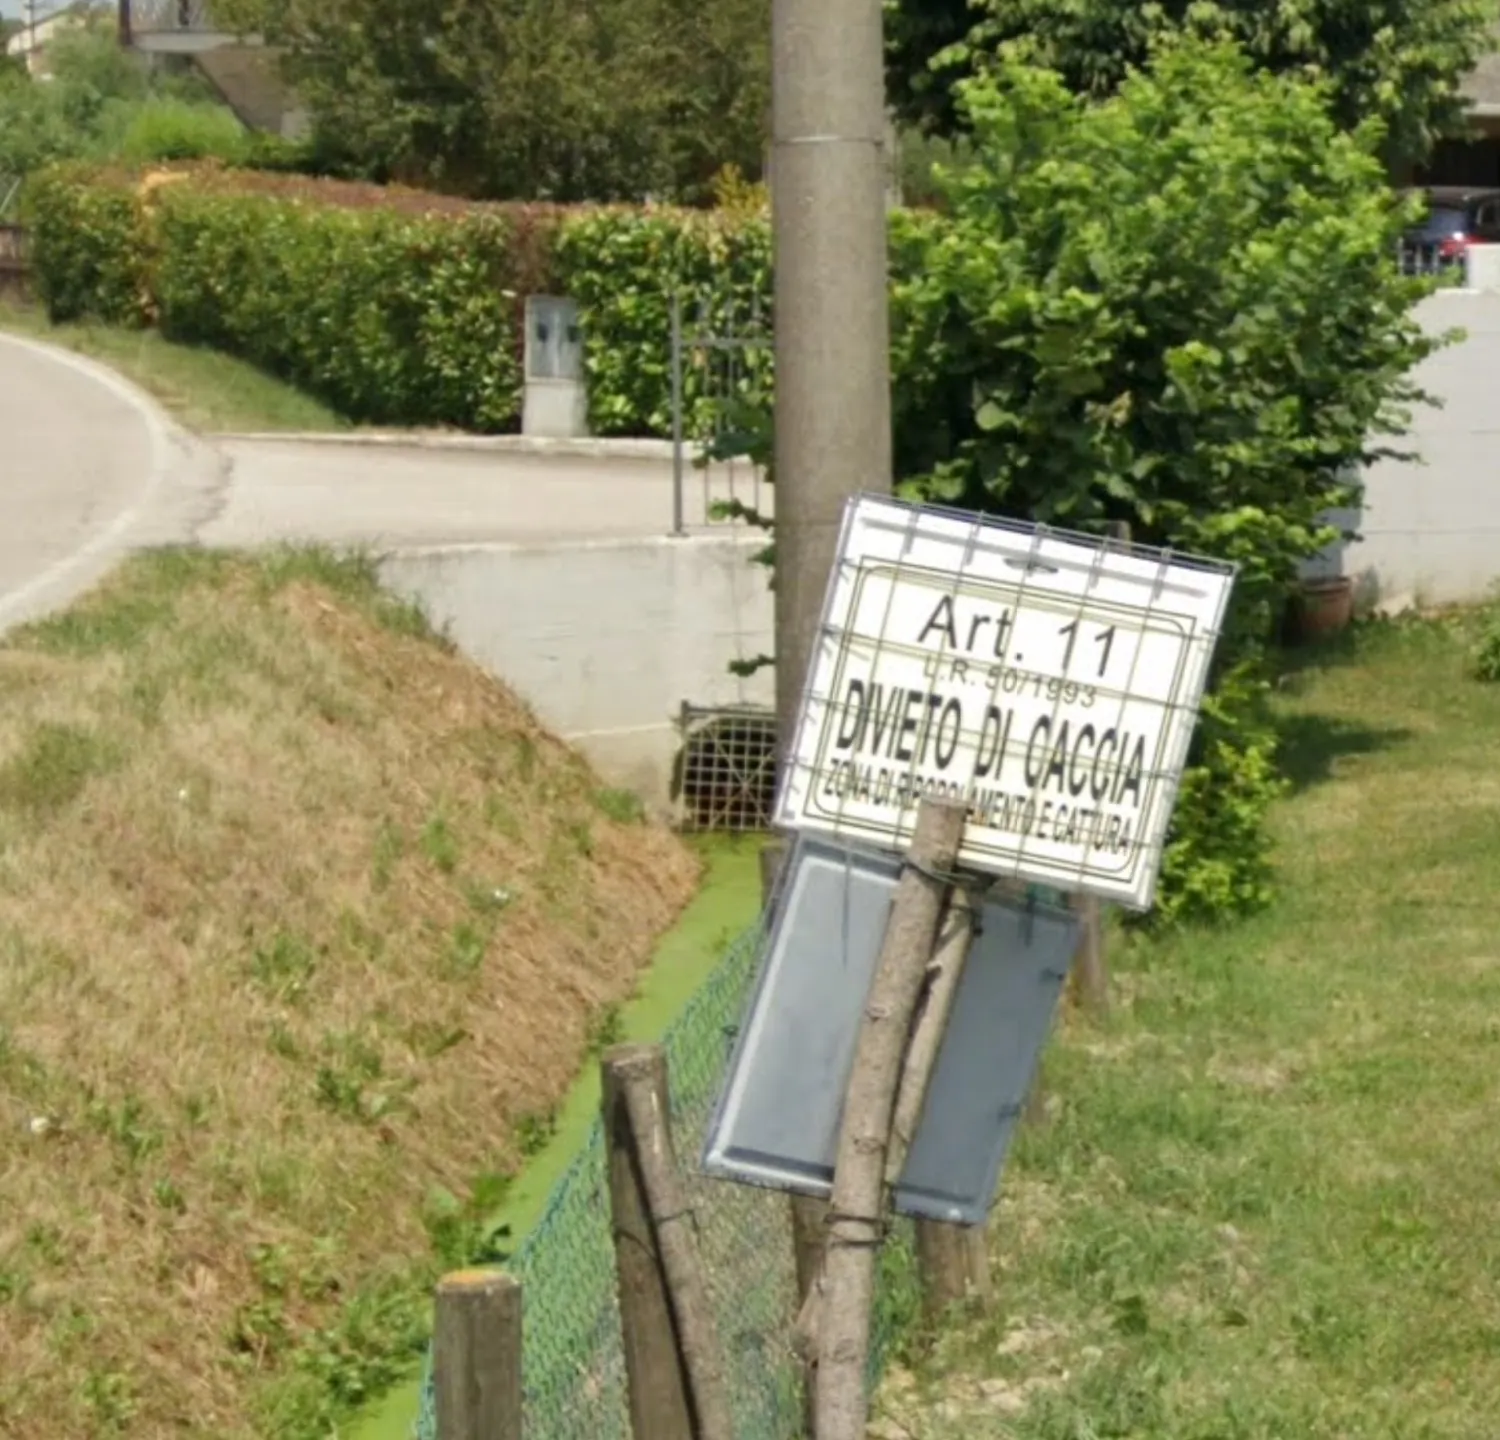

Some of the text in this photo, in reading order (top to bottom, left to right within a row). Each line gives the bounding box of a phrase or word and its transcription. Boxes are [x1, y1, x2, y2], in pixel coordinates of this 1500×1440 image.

[917, 594, 1117, 678] Art. 11
[984, 664, 1098, 708] 50/1993
[836, 678, 1147, 809] DIVIETO DI CACCIA
[823, 758, 872, 803] ZONA
[873, 768, 895, 807] DI
[1036, 800, 1053, 839] E
[1053, 804, 1134, 855] CATTURA
